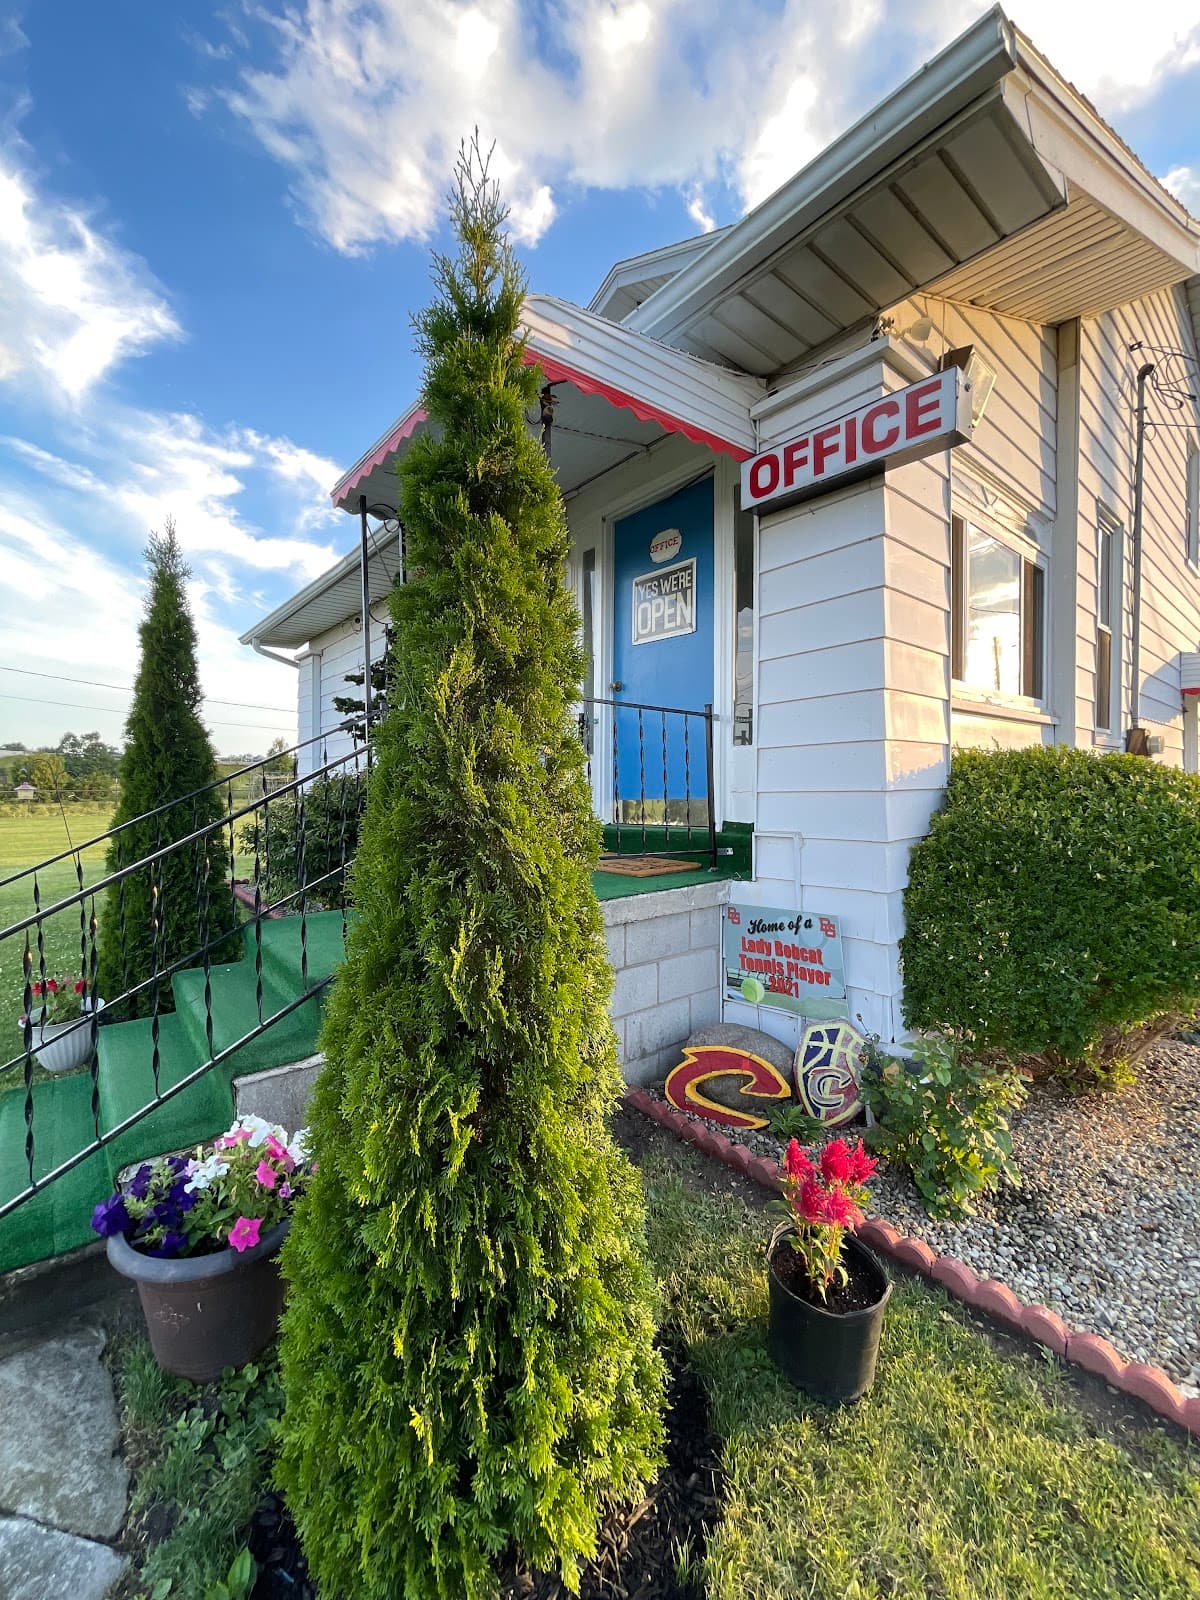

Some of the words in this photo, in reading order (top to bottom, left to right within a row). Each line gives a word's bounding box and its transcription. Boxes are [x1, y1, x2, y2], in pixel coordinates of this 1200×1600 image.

[750, 379, 942, 499] OFFICE
[650, 537, 679, 553] OFFICE
[638, 581, 659, 600] YES
[638, 588, 692, 635] OPEN
[747, 919, 785, 934] Home
[787, 914, 803, 936] of
[804, 918, 813, 929] a
[742, 936, 772, 956] Lady
[775, 940, 823, 965] Bobcat
[739, 954, 784, 976] Tennis
[786, 961, 831, 985] Player
[768, 976, 799, 998] 2021
